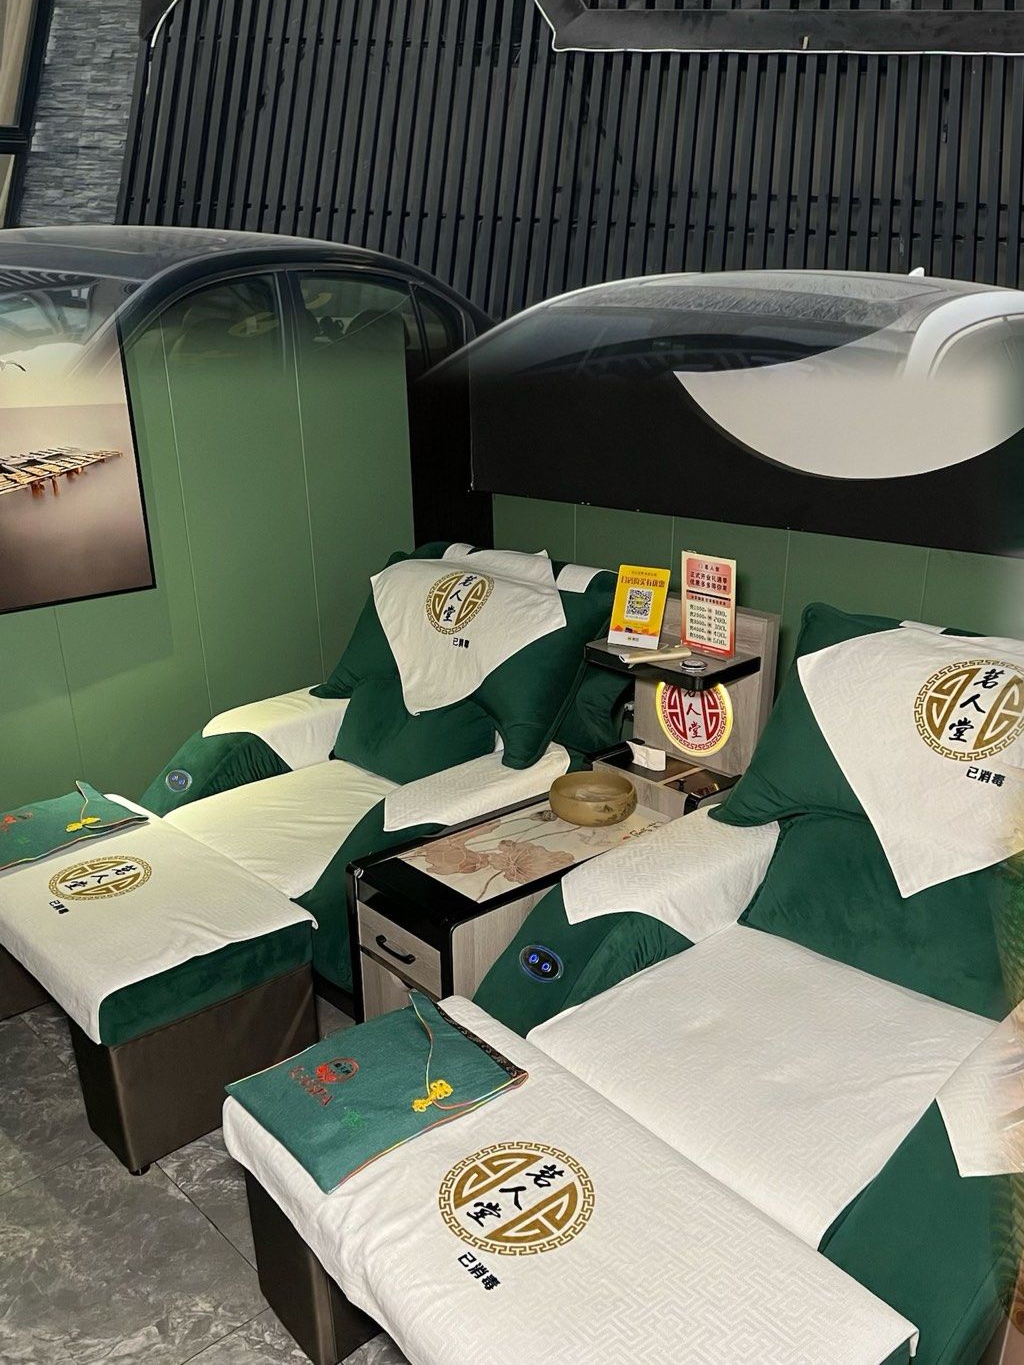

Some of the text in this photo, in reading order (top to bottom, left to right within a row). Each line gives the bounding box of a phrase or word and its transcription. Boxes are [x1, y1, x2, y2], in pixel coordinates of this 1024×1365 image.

[442, 575, 478, 622] 茗人堂
[948, 668, 1005, 743] 茗人堂
[966, 766, 1006, 787] 已消毒
[64, 864, 138, 891] 茗人堂
[465, 1163, 566, 1228] 茗人堂
[457, 1250, 502, 1292] 已消毒
